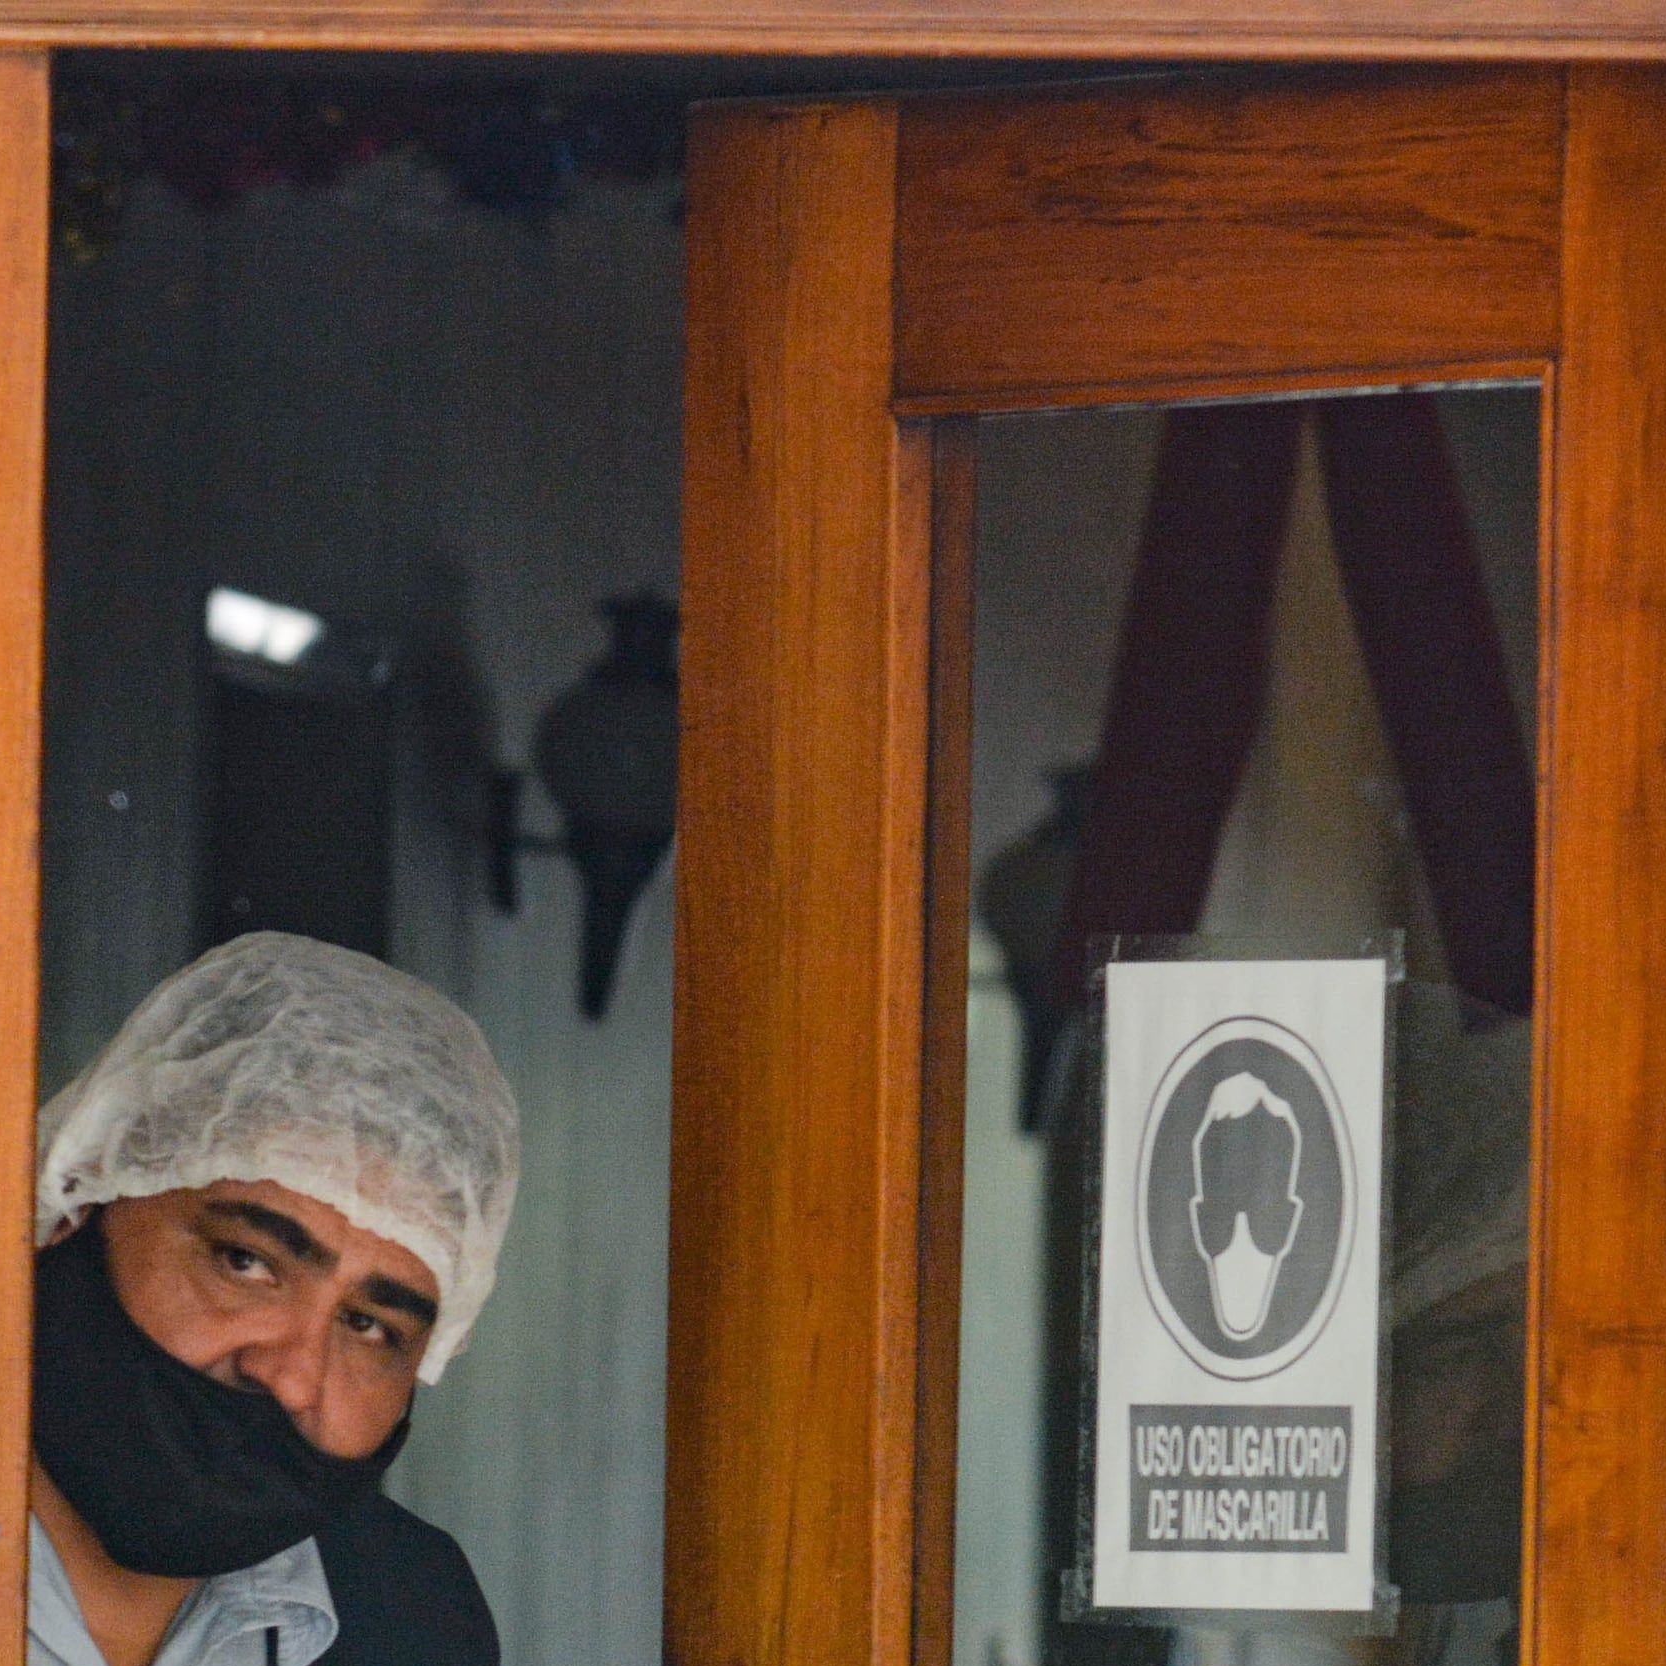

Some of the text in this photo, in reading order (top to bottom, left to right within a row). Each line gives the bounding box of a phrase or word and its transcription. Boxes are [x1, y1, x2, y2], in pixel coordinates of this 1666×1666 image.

[1136, 1425, 1347, 1479] USO OBLIGATORIO
[1147, 1489, 1330, 1541] DE MASCARILLA
